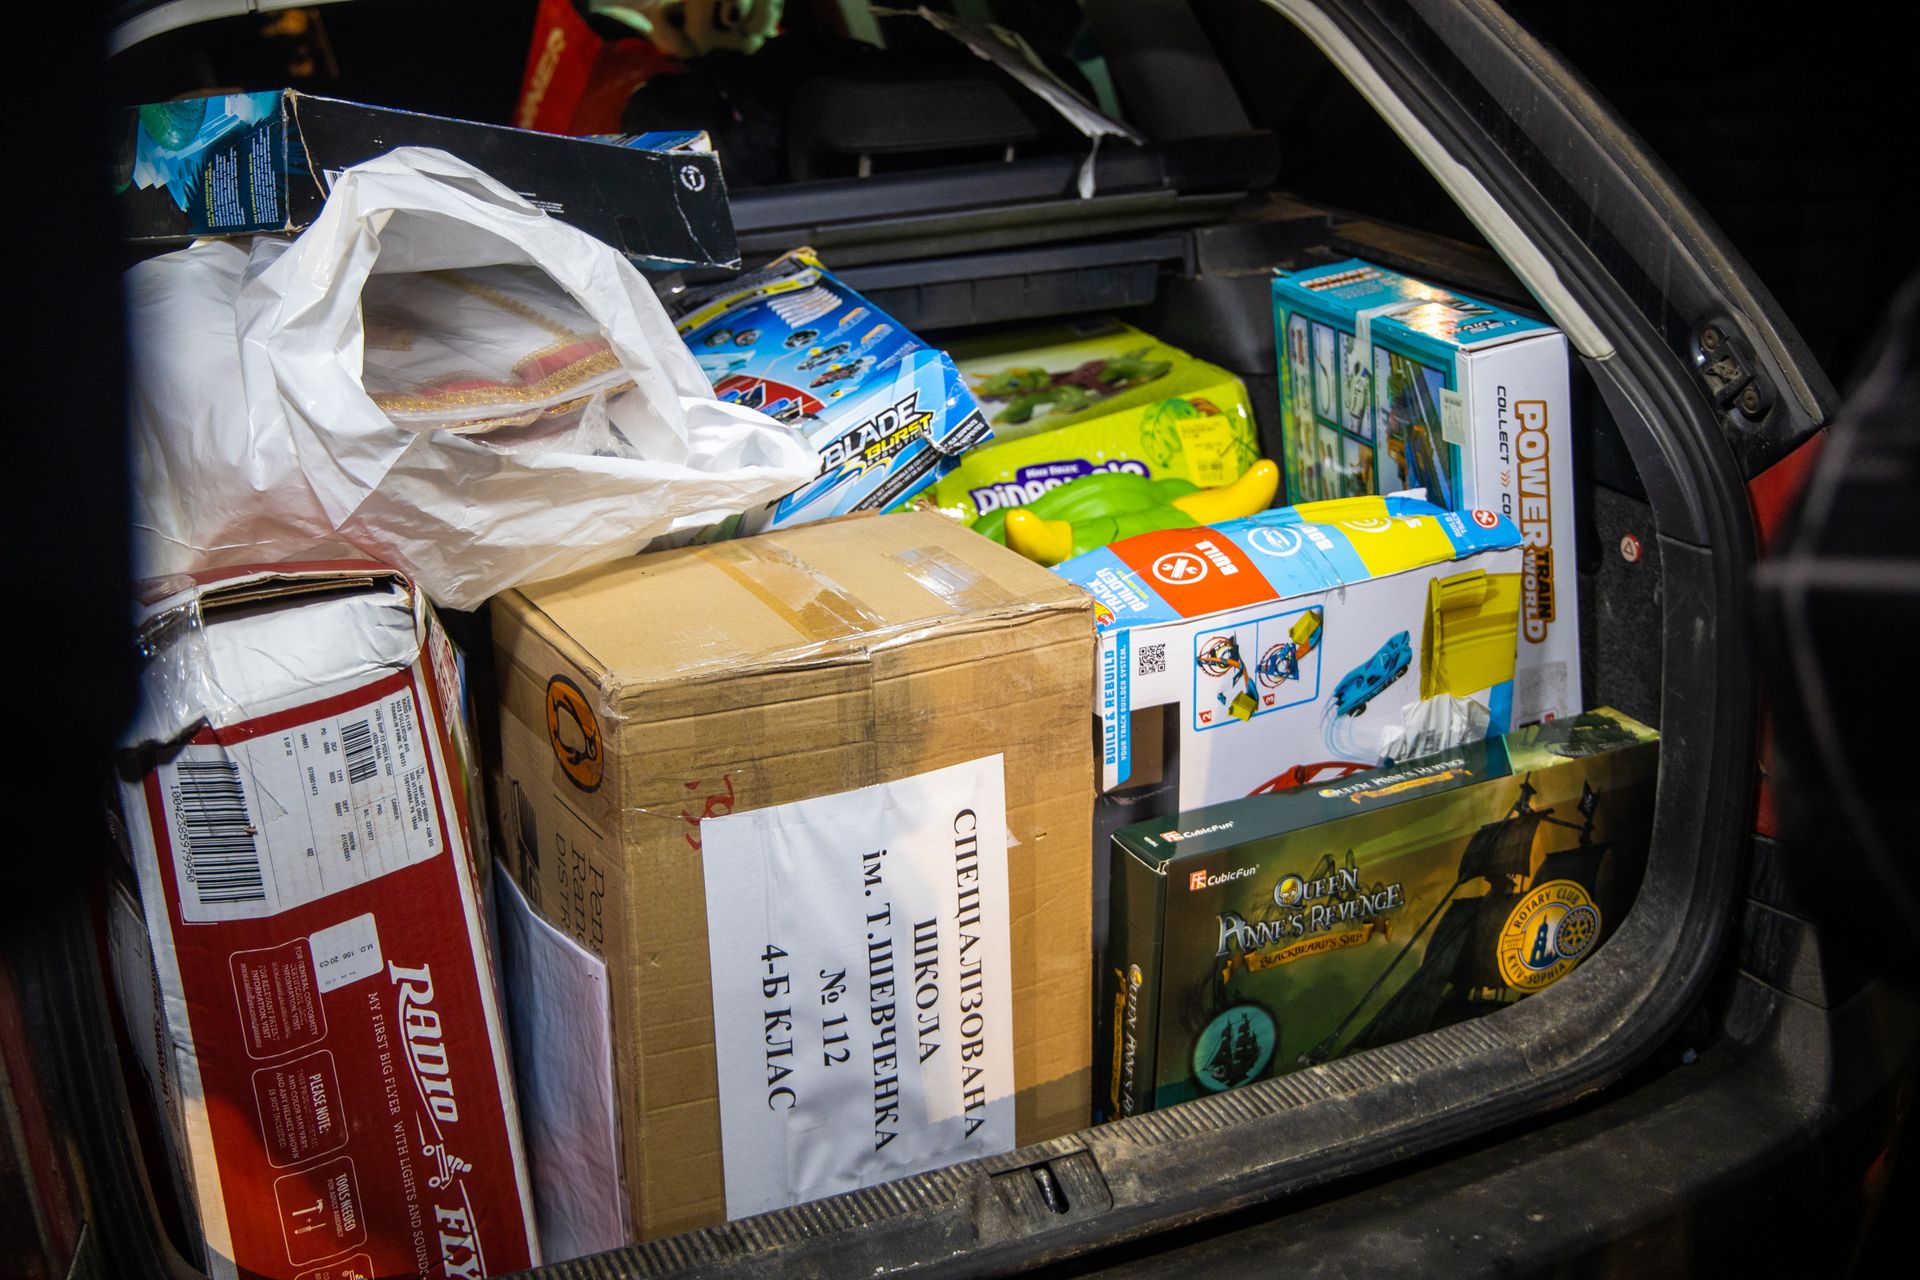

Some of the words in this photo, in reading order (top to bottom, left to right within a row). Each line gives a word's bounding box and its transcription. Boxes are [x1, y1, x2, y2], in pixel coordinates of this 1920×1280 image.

[866, 413, 933, 457] BURST
[1495, 385, 1511, 464] COLLECT
[1508, 401, 1560, 549] POWER
[1195, 540, 1239, 576] BUILD
[1087, 578, 1127, 612] TRACK
[1096, 567, 1148, 612] BUILDER
[1517, 555, 1544, 642] WORLD
[1532, 550, 1558, 621] TRAIN
[1103, 649, 1115, 707] REBUILD
[1119, 644, 1127, 677] SYSTEM.
[1105, 711, 1115, 720] &
[1104, 724, 1115, 764] BUILD
[862, 849, 888, 897] ім.
[1207, 865, 1256, 886] CubicFun
[1514, 891, 1551, 928] ROTARY
[1556, 888, 1580, 905] CLUB
[760, 943, 791, 999] 4-Б
[819, 967, 847, 1006] №
[913, 916, 941, 1065] ШКОЛА
[953, 808, 987, 1140] СПЕЦІАЛІЗОВАНА
[367, 991, 381, 1011] MY
[371, 1013, 389, 1050] FIRST
[387, 953, 459, 1128] RADIO
[821, 1018, 851, 1068] 112
[866, 902, 899, 1152] Т.ШЕВЧЕНКА
[378, 1052, 393, 1075] BIG
[764, 1009, 797, 1111] КЛАС
[308, 1072, 326, 1107] PLEASE
[382, 1076, 401, 1116] FLYER
[282, 1103, 293, 1132] HELMET
[288, 1132, 299, 1159] SHOWN
[314, 1105, 332, 1134] NOTE:
[392, 1120, 409, 1155] WITH
[334, 1173, 350, 1200] TOOLS
[398, 1157, 417, 1201] LIGHTS
[340, 1199, 356, 1232] NEEDED
[407, 1202, 422, 1229] AND
